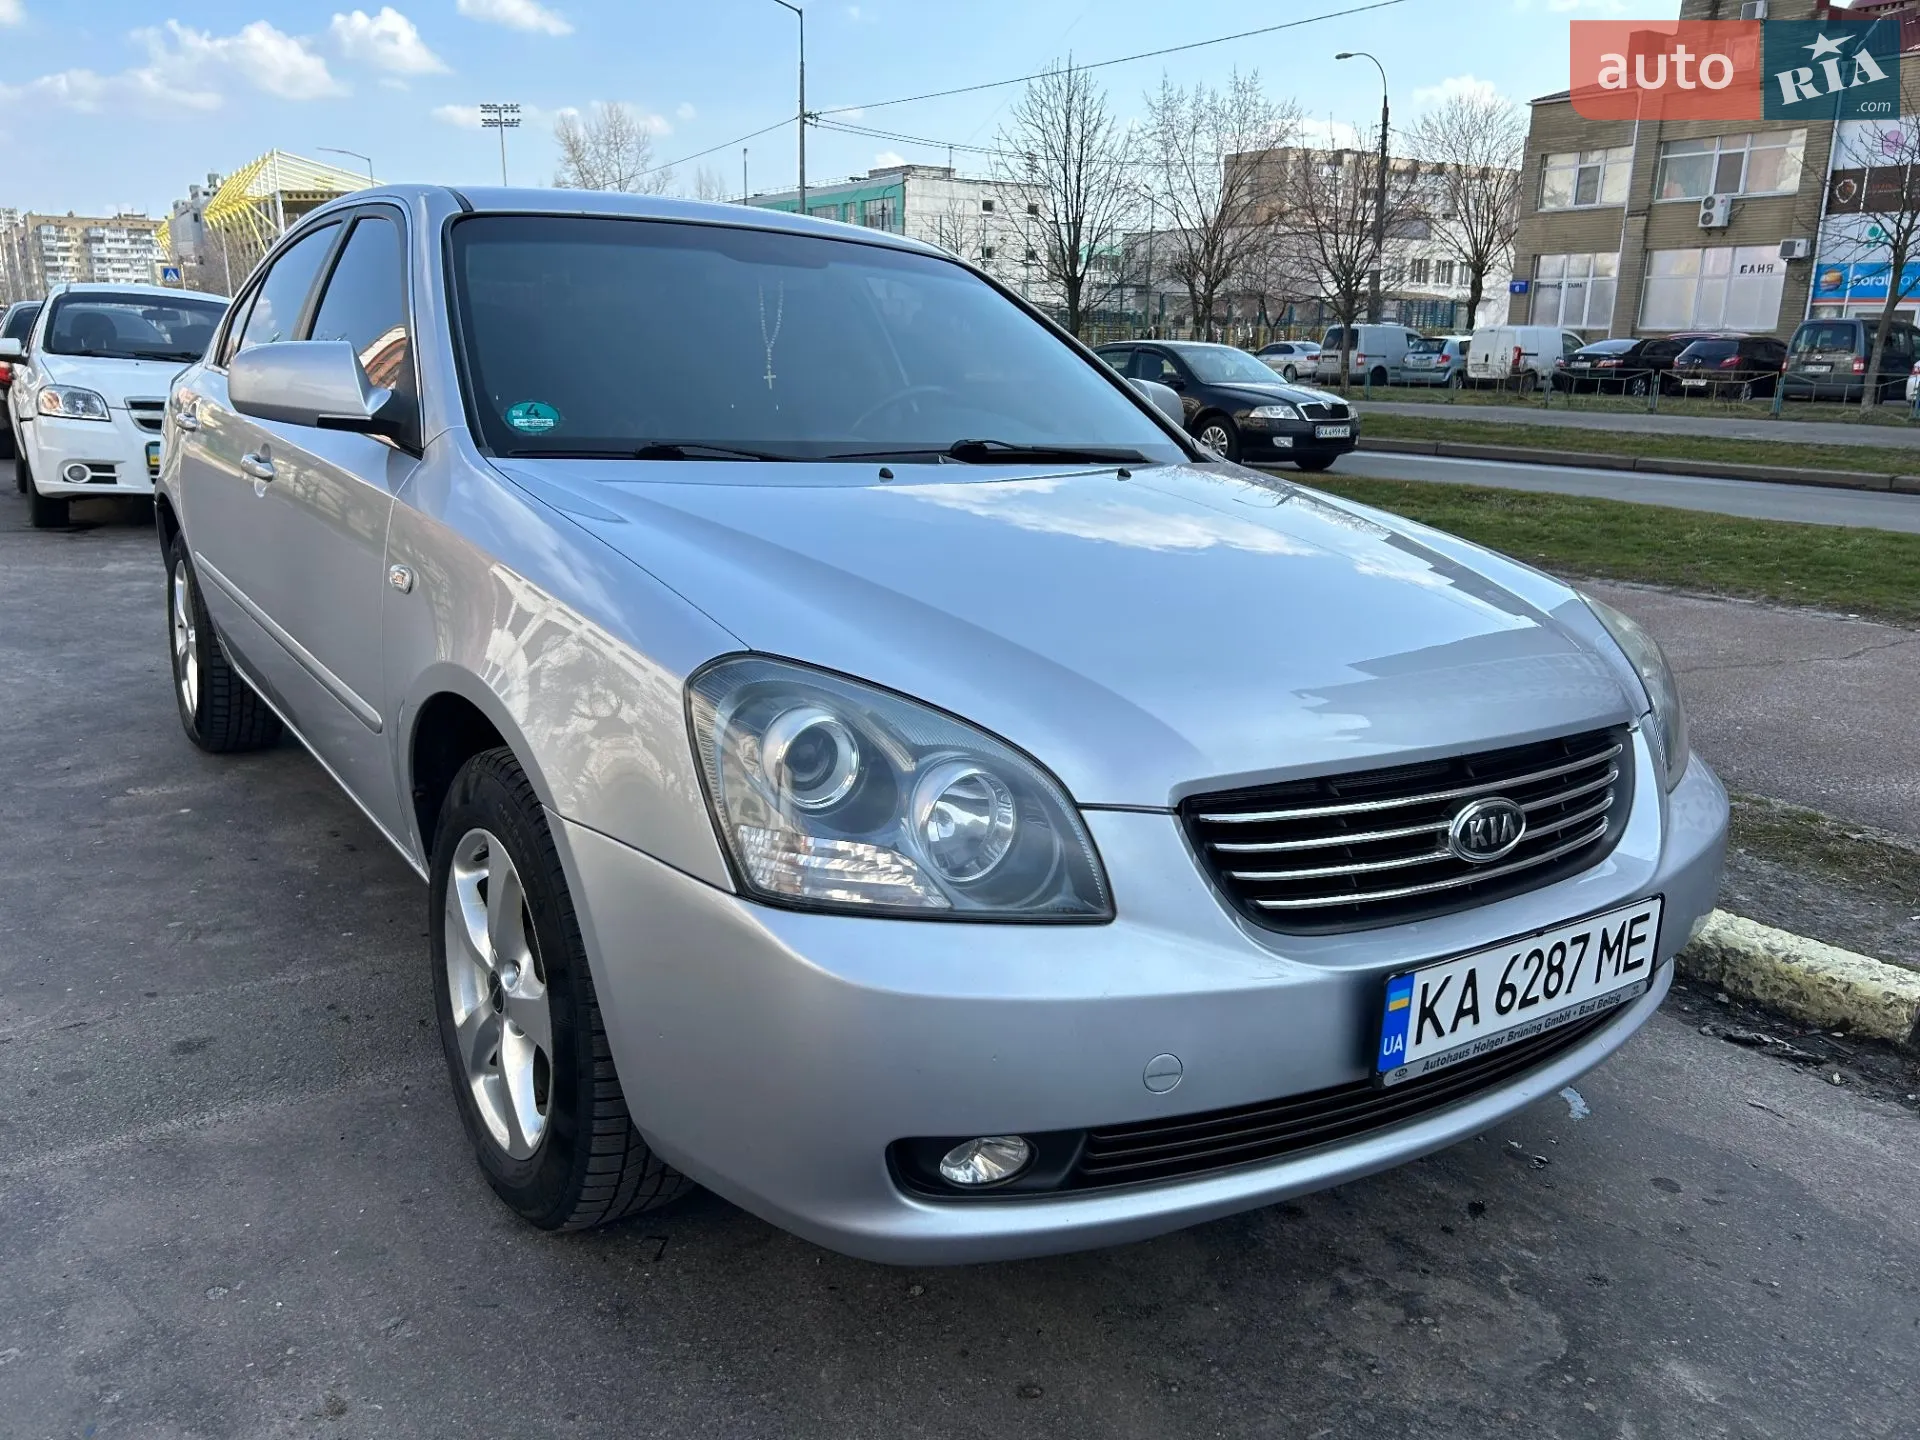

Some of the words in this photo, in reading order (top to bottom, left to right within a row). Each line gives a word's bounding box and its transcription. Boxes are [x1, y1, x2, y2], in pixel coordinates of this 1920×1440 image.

[1740, 264, 1774, 274] БАНЯ
[526, 404, 540, 417] 4
[1469, 813, 1516, 848] KIA
[1415, 968, 1480, 1045] KA
[1495, 932, 1590, 1016] 6287
[1595, 912, 1650, 984] ME
[1383, 1034, 1403, 1055] UA
[1422, 1048, 1470, 1072] Autohaus
[1473, 1035, 1505, 1054] Holger
[1507, 1023, 1543, 1041] Brüning
[1544, 1010, 1571, 1028] GmbH
[1579, 1001, 1595, 1015] Bad
